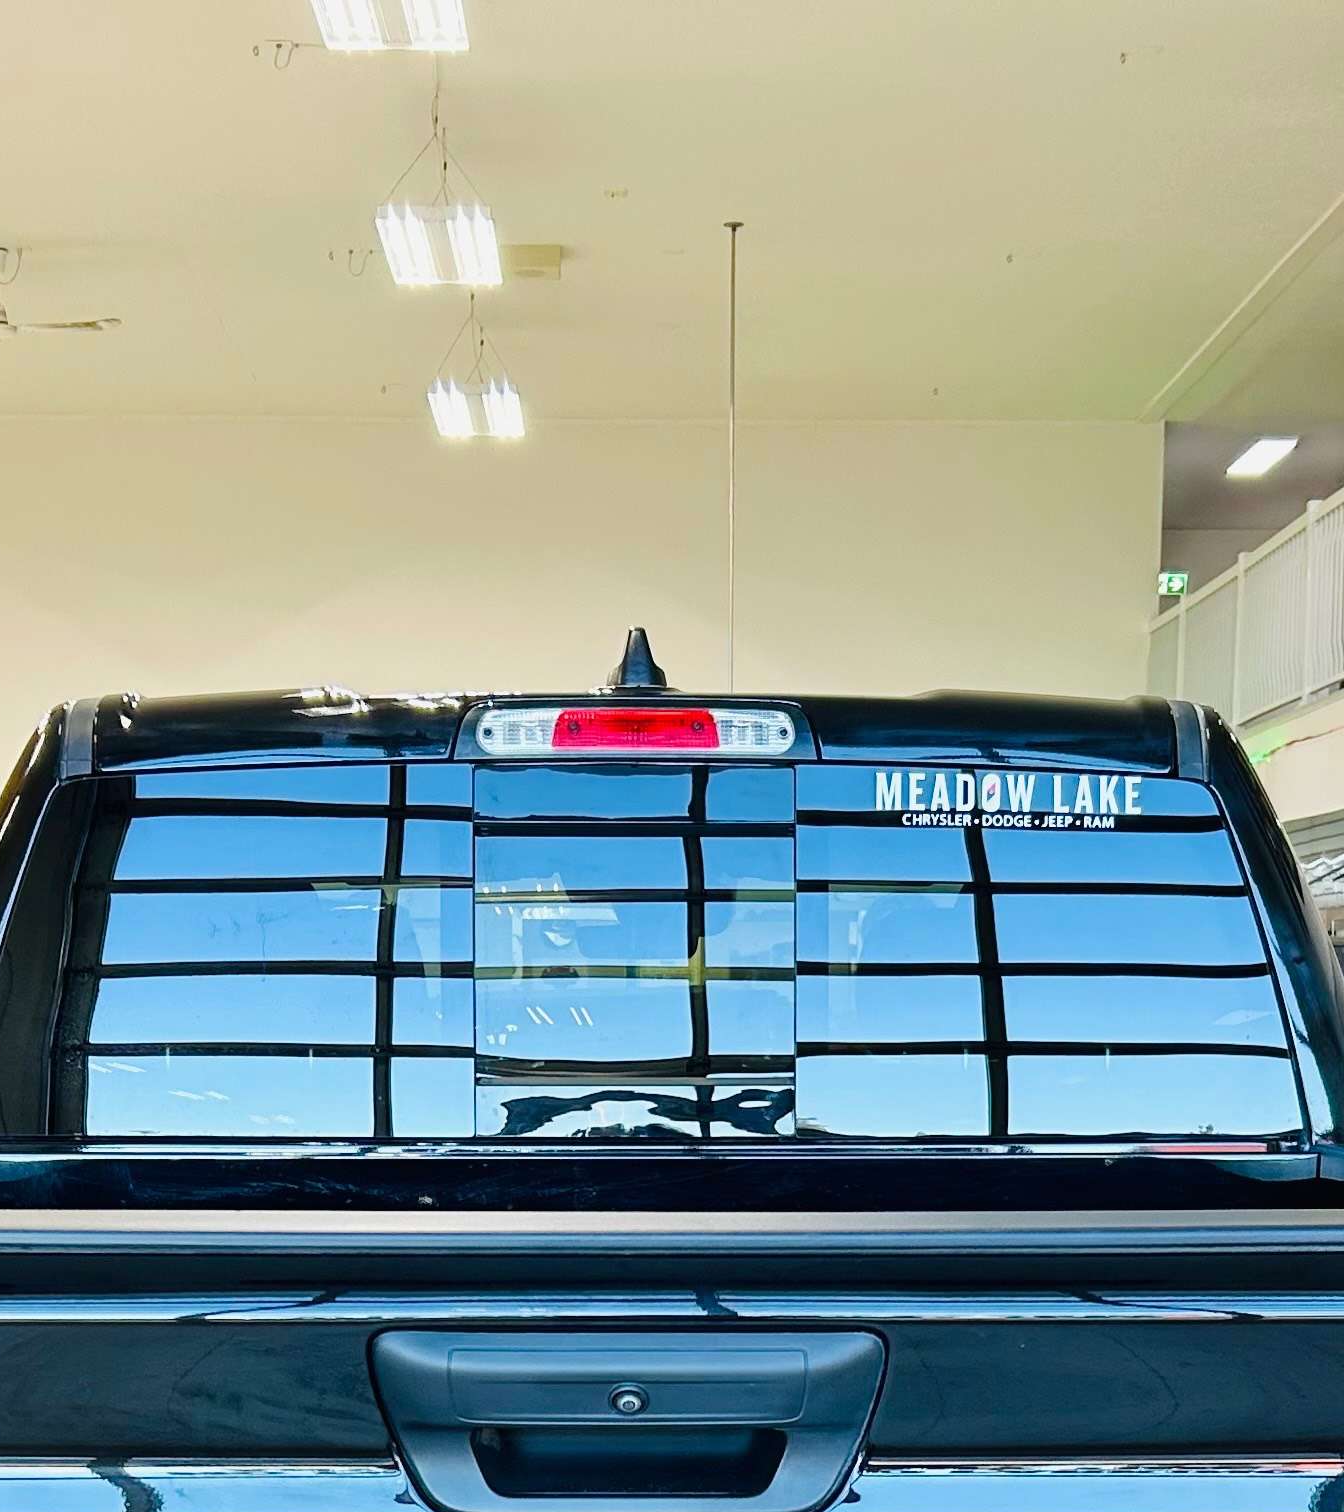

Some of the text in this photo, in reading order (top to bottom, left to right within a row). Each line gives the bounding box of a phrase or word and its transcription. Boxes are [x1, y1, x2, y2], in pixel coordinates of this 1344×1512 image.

[875, 772, 1143, 815] MEADOW LAKE
[902, 813, 1115, 829] CHRYSLER DODGE JEEP RAM
